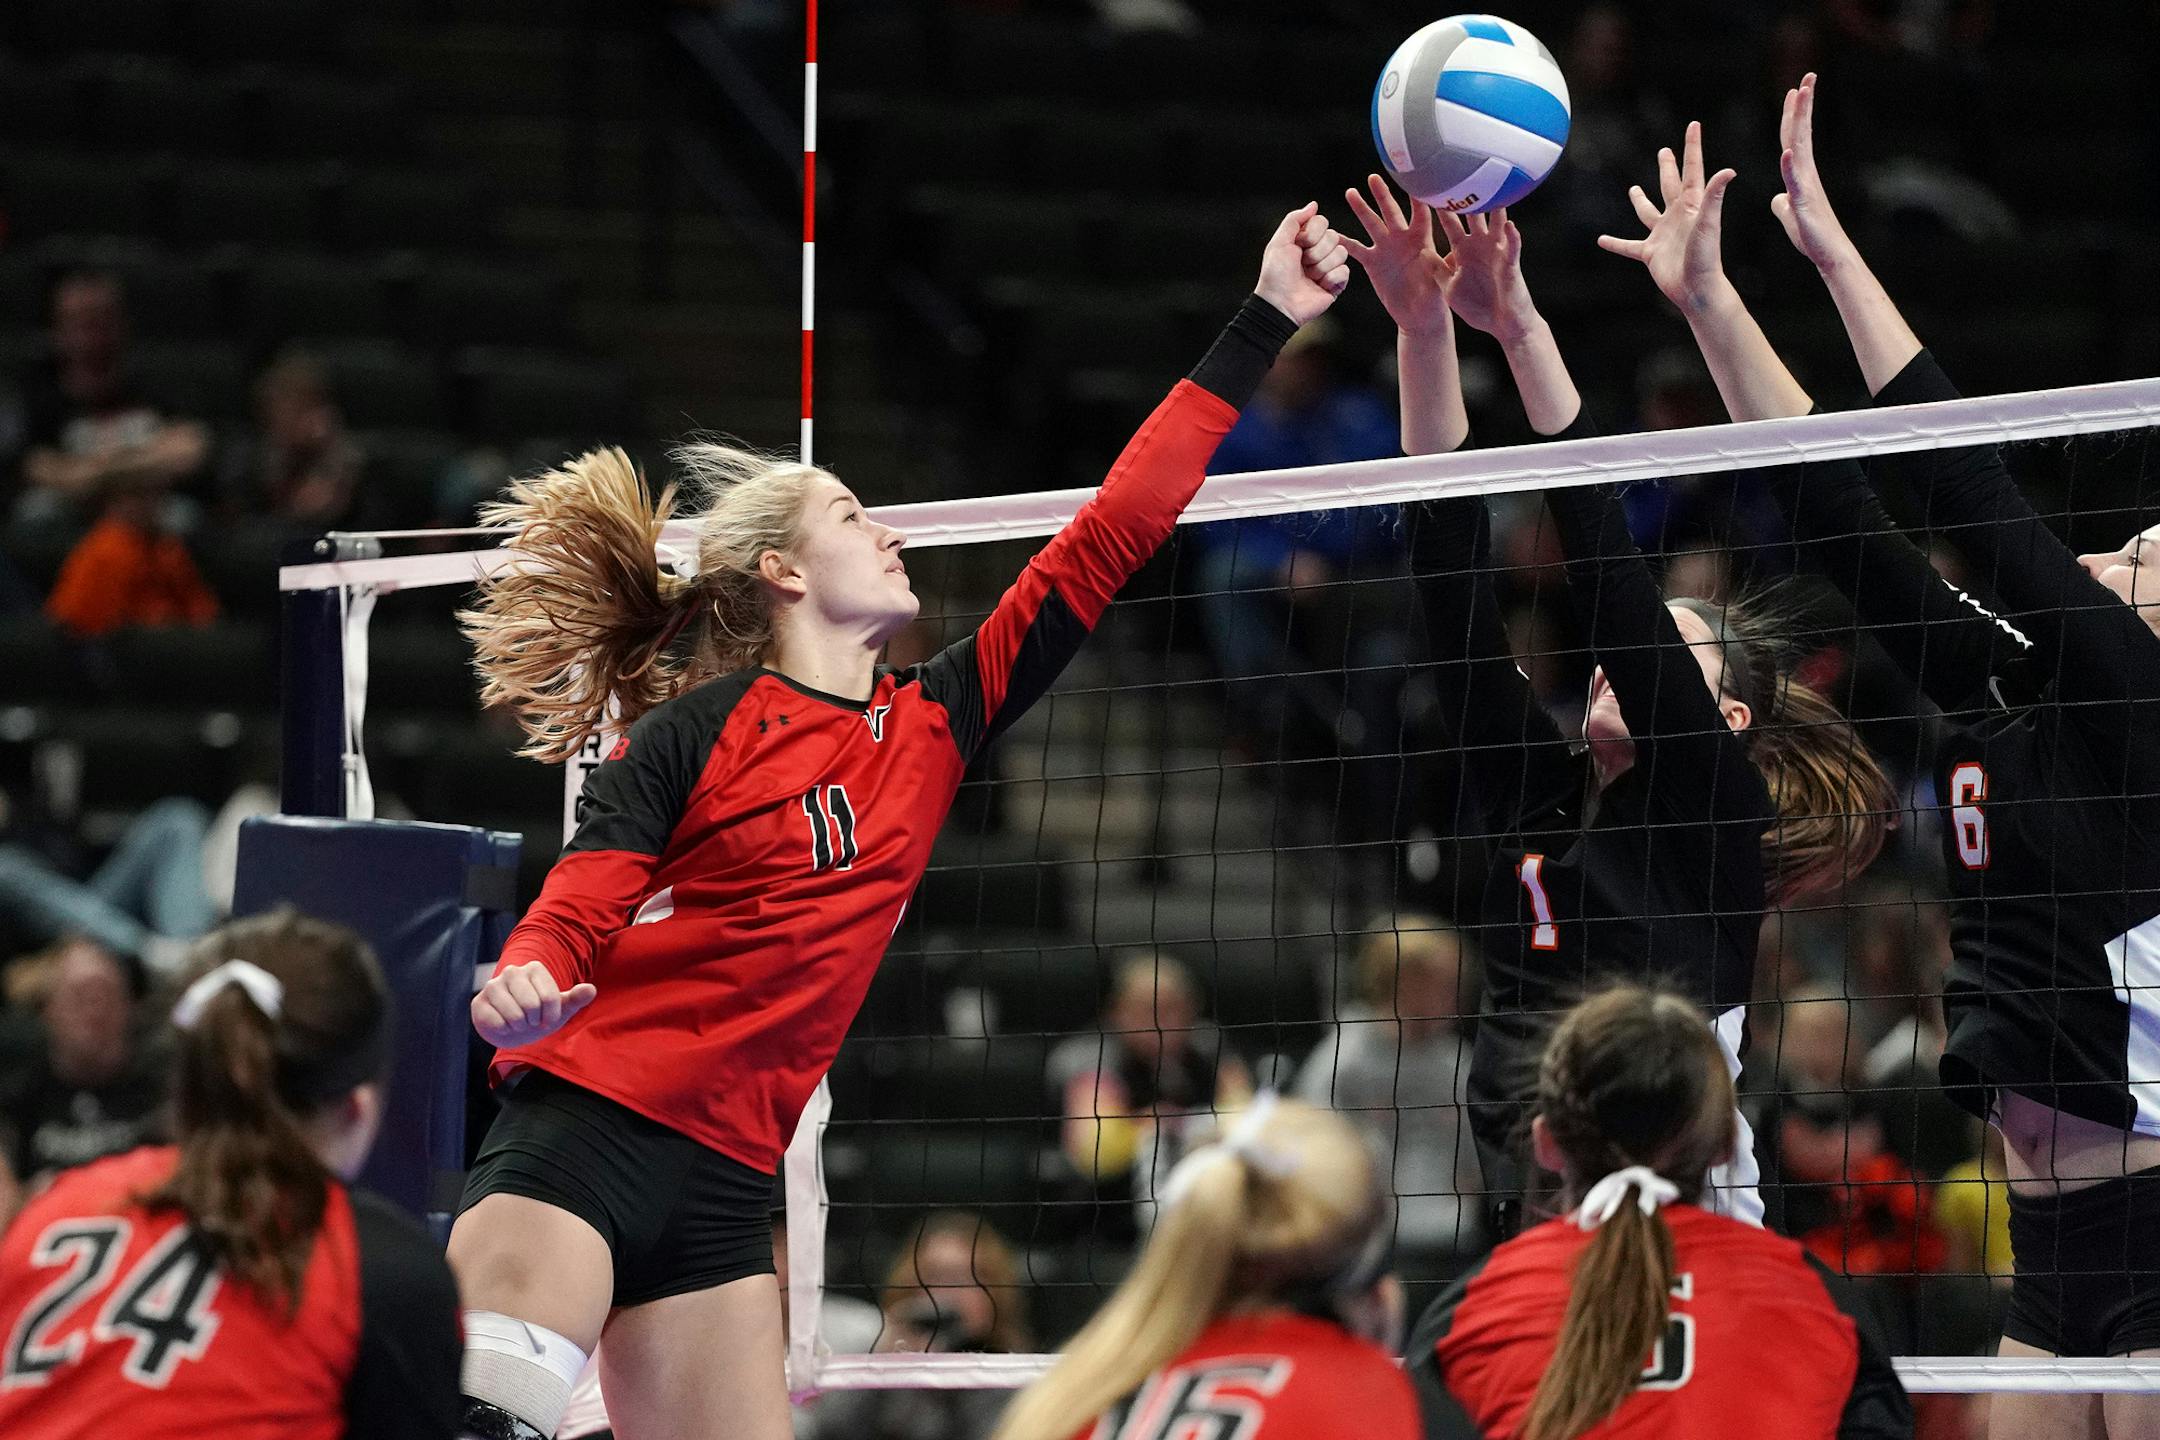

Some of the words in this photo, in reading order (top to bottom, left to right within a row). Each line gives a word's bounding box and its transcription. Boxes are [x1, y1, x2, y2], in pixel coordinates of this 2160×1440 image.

[802, 784, 858, 872] 11
[1949, 761, 1990, 870] 6
[1514, 853, 1560, 951] 1
[0, 1215, 222, 1391] 24
